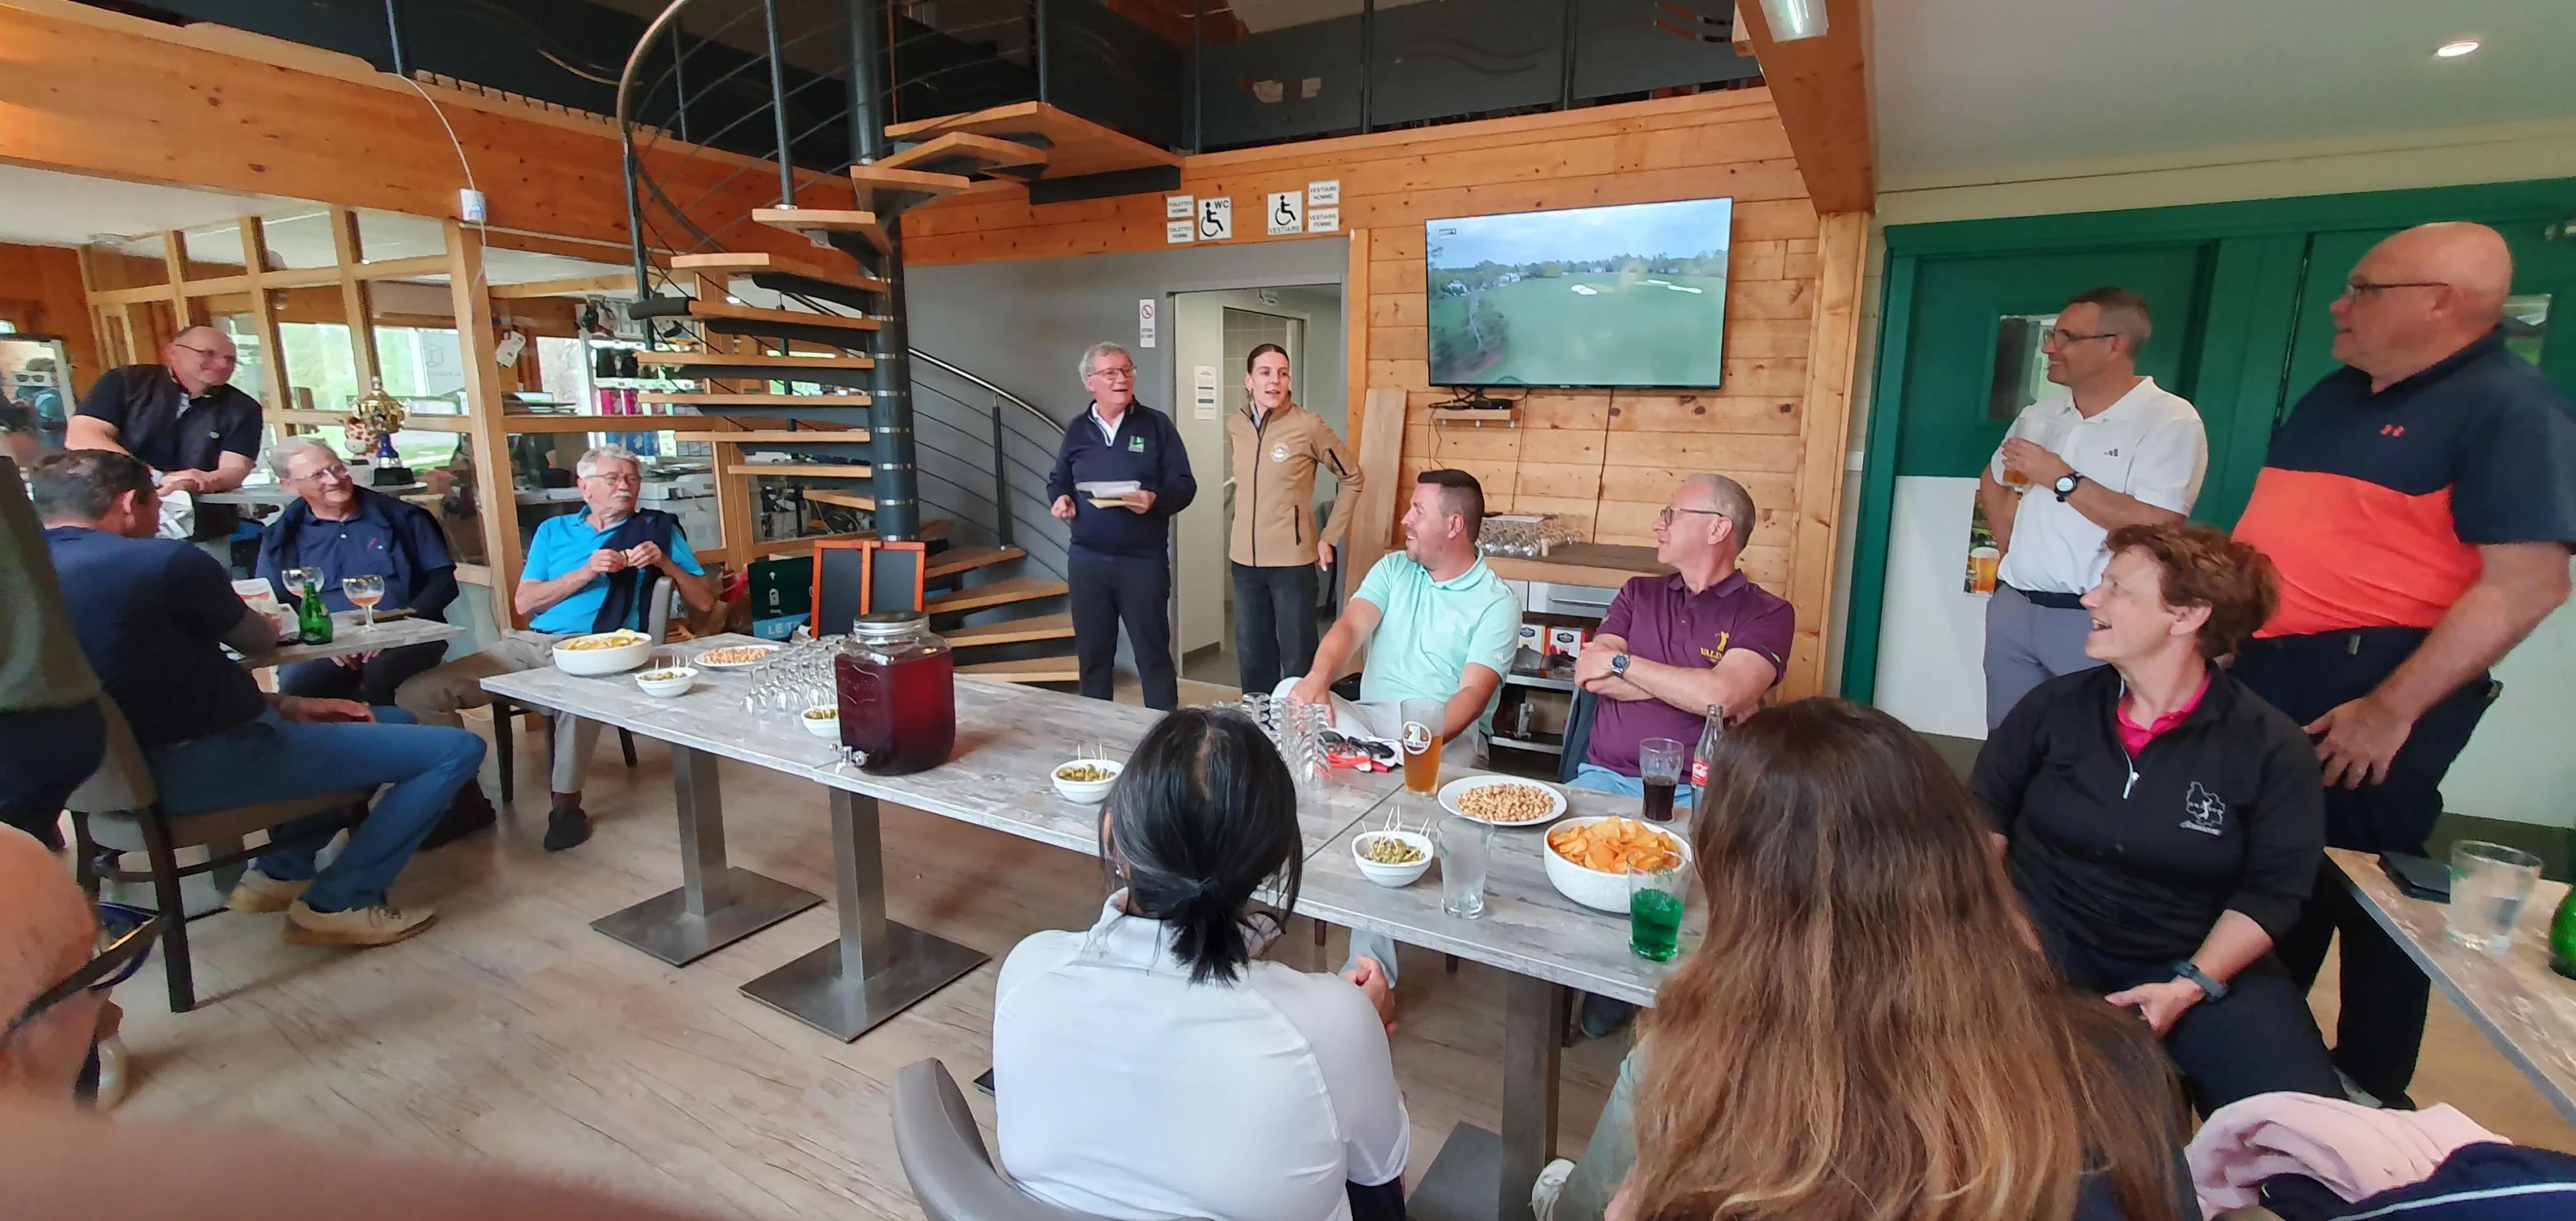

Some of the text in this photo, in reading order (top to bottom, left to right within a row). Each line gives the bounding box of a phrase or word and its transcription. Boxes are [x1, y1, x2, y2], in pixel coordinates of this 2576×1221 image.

[1214, 199, 1229, 209] WC
[1269, 225, 1299, 234] VESTIAIRE
[768, 623, 783, 635] LE
